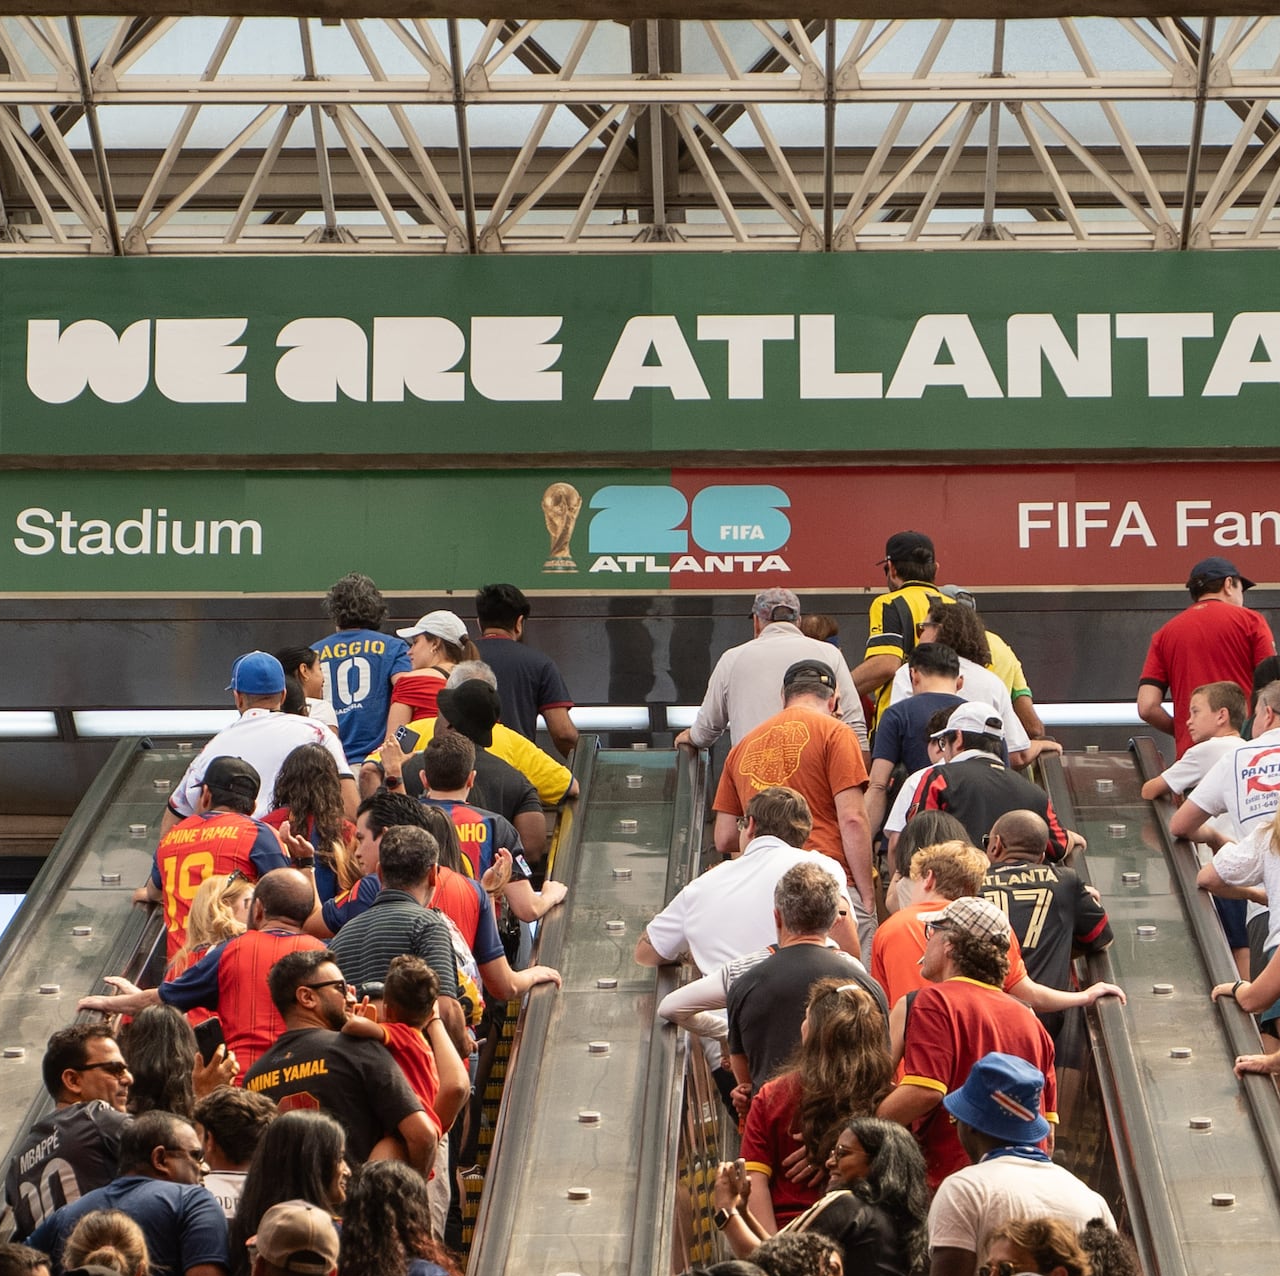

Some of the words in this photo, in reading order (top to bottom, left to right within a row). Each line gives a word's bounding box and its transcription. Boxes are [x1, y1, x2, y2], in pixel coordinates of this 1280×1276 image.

[27, 318, 248, 404] WE
[588, 485, 792, 553] 26
[1018, 501, 1158, 549] FIFA
[14, 508, 263, 556] Stadium
[720, 525, 765, 541] FIFA
[588, 555, 791, 573] ATLANTA
[200, 826, 239, 841] YAMAL
[982, 867, 1059, 886] TLANTA
[282, 1058, 329, 1082] YAMAL
